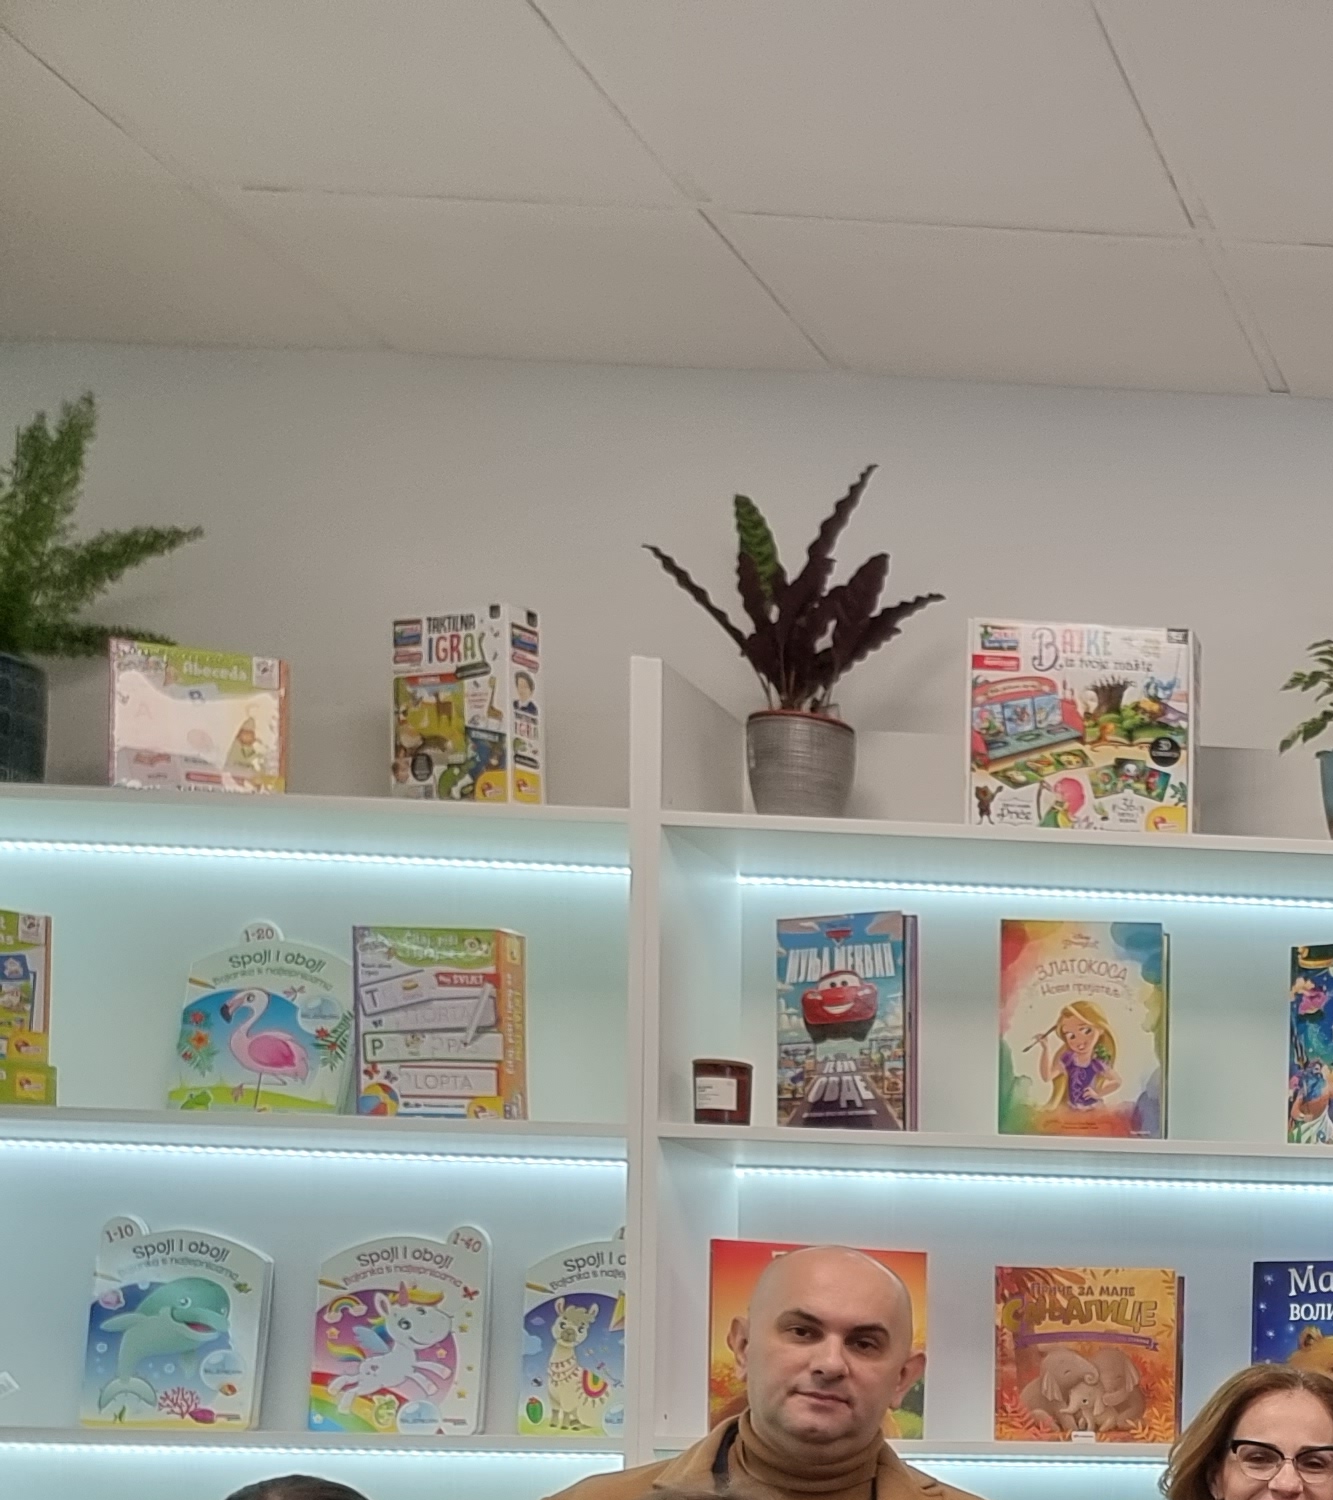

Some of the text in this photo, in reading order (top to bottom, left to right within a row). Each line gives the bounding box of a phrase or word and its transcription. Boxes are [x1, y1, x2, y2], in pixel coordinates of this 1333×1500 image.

[1036, 958, 1129, 982] ЗЛАТОКОСА
[105, 1223, 135, 1244] 1-10
[452, 1231, 482, 1253] 1-40
[1077, 1286, 1095, 1298] ЗА
[1099, 1285, 1136, 1298] МАЛЕ
